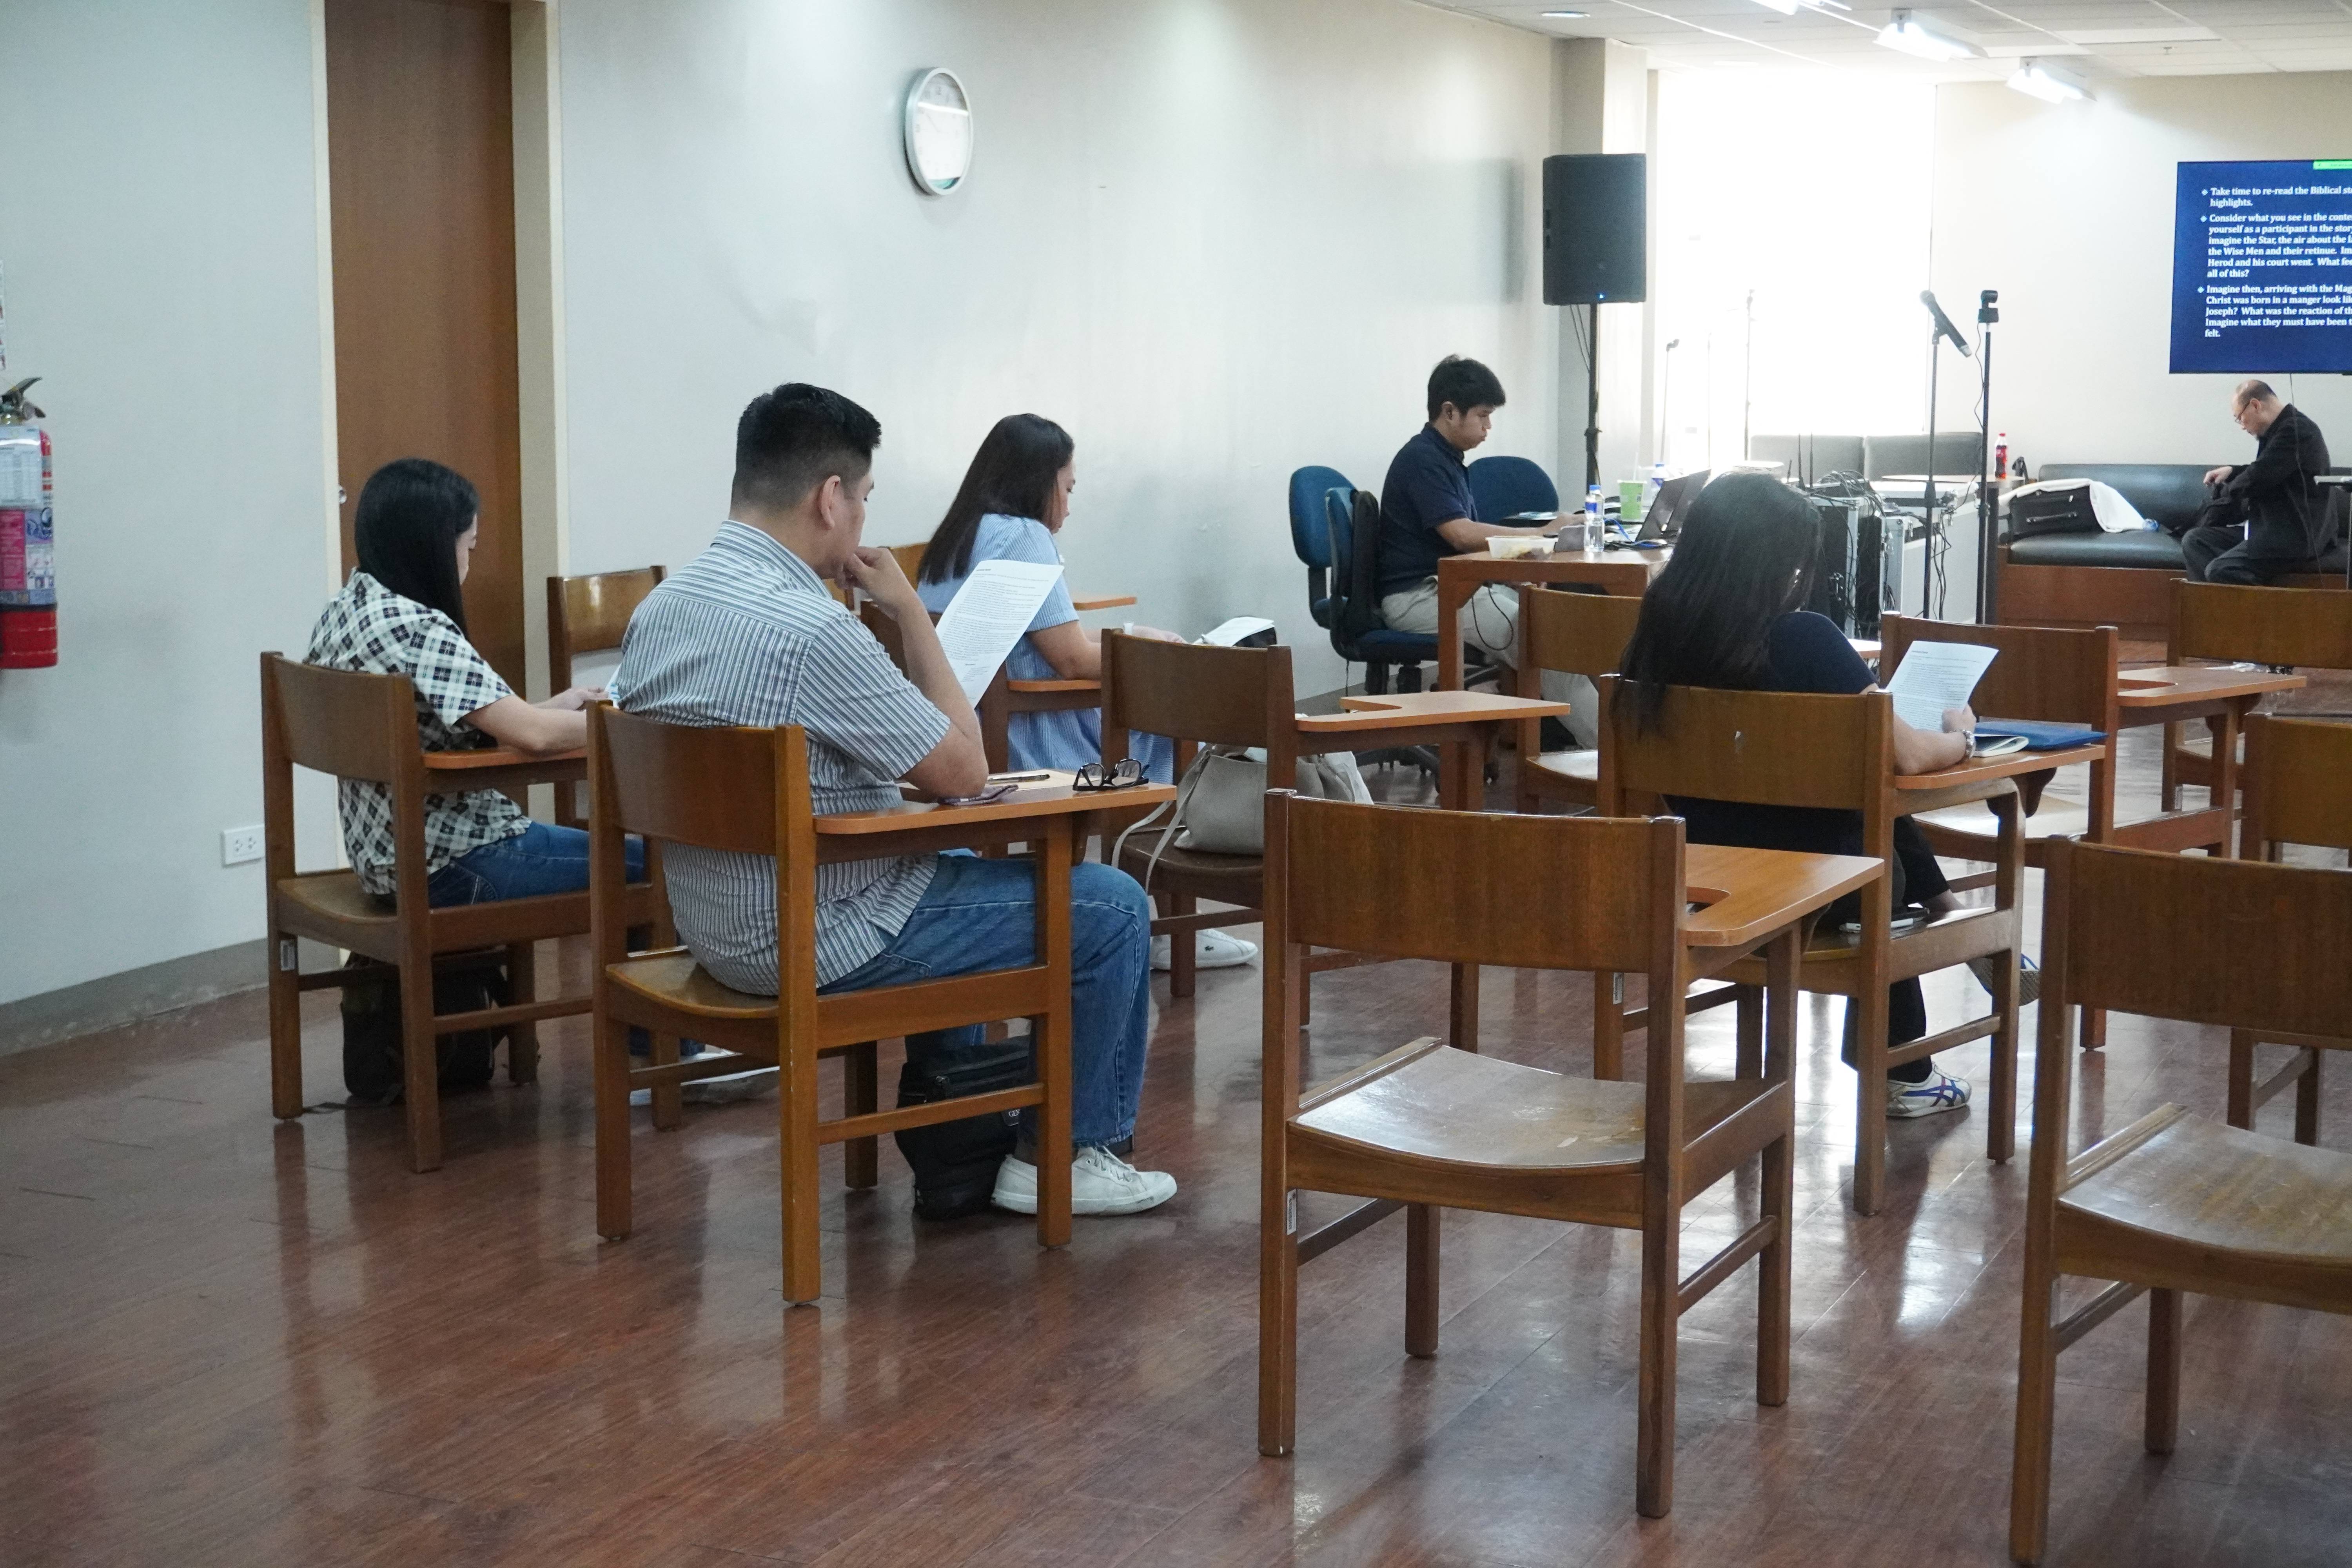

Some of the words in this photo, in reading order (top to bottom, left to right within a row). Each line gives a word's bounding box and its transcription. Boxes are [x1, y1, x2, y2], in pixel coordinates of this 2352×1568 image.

[2263, 187, 2293, 195] re-read
[2310, 186, 2341, 194] Biblical
[2210, 198, 2253, 209] highlights.
[2209, 225, 2243, 235] yourself
[2262, 225, 2308, 234] participant
[2209, 237, 2241, 246] imagine
[2258, 236, 2277, 244] Star,
[2278, 236, 2292, 244] the
[2348, 235, 2352, 243] l
[2265, 247, 2281, 255] and
[2283, 247, 2303, 255] their
[2208, 258, 2234, 267] Herod
[2252, 258, 2265, 266] his
[2207, 285, 2240, 295] Imagine
[2242, 285, 2263, 294] then,
[2264, 285, 2298, 294] arriving
[2319, 284, 2333, 292] the
[2251, 296, 2270, 304] born
[2206, 307, 2238, 317] Joseph?
[2206, 318, 2239, 328] Imagine
[2263, 318, 2281, 327] they
